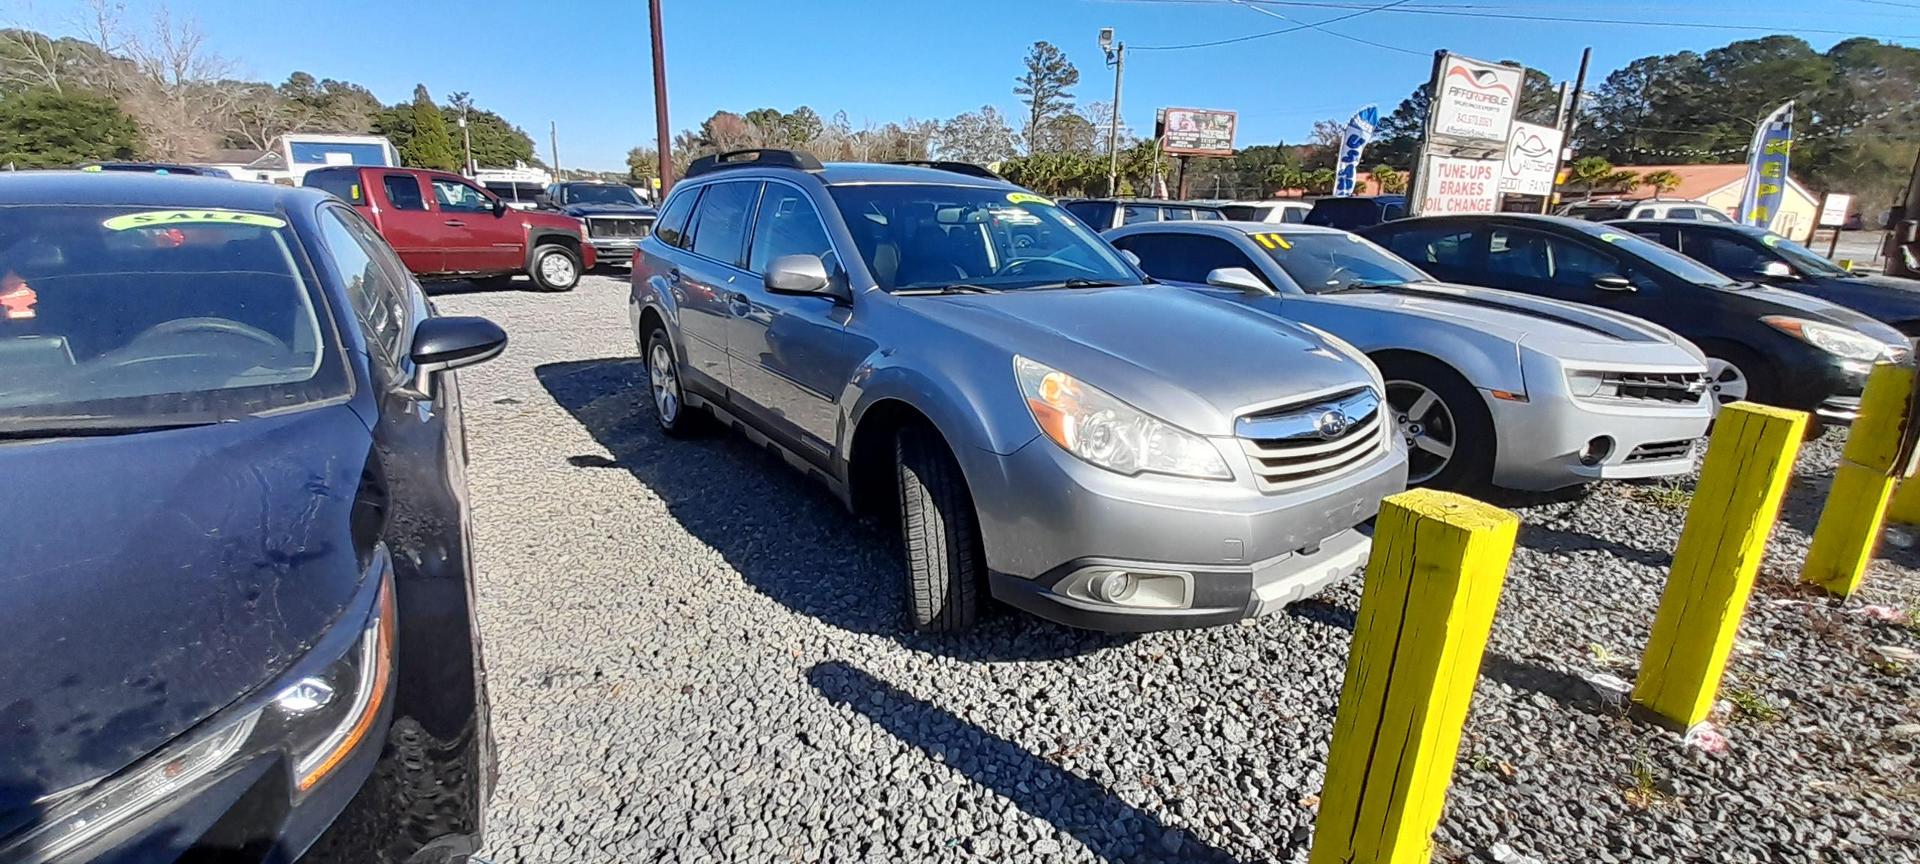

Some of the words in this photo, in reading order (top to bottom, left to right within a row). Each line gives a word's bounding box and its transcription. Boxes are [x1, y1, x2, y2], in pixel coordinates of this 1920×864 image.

[1448, 86, 1510, 106] AFFORDABLE
[1438, 163, 1492, 180] TUNE-UPS
[1440, 181, 1484, 196] BRAKES
[1425, 197, 1443, 212] OIL
[1447, 197, 1492, 212] CHANGE
[133, 213, 250, 223] SALE
[1255, 233, 1292, 250] 11
